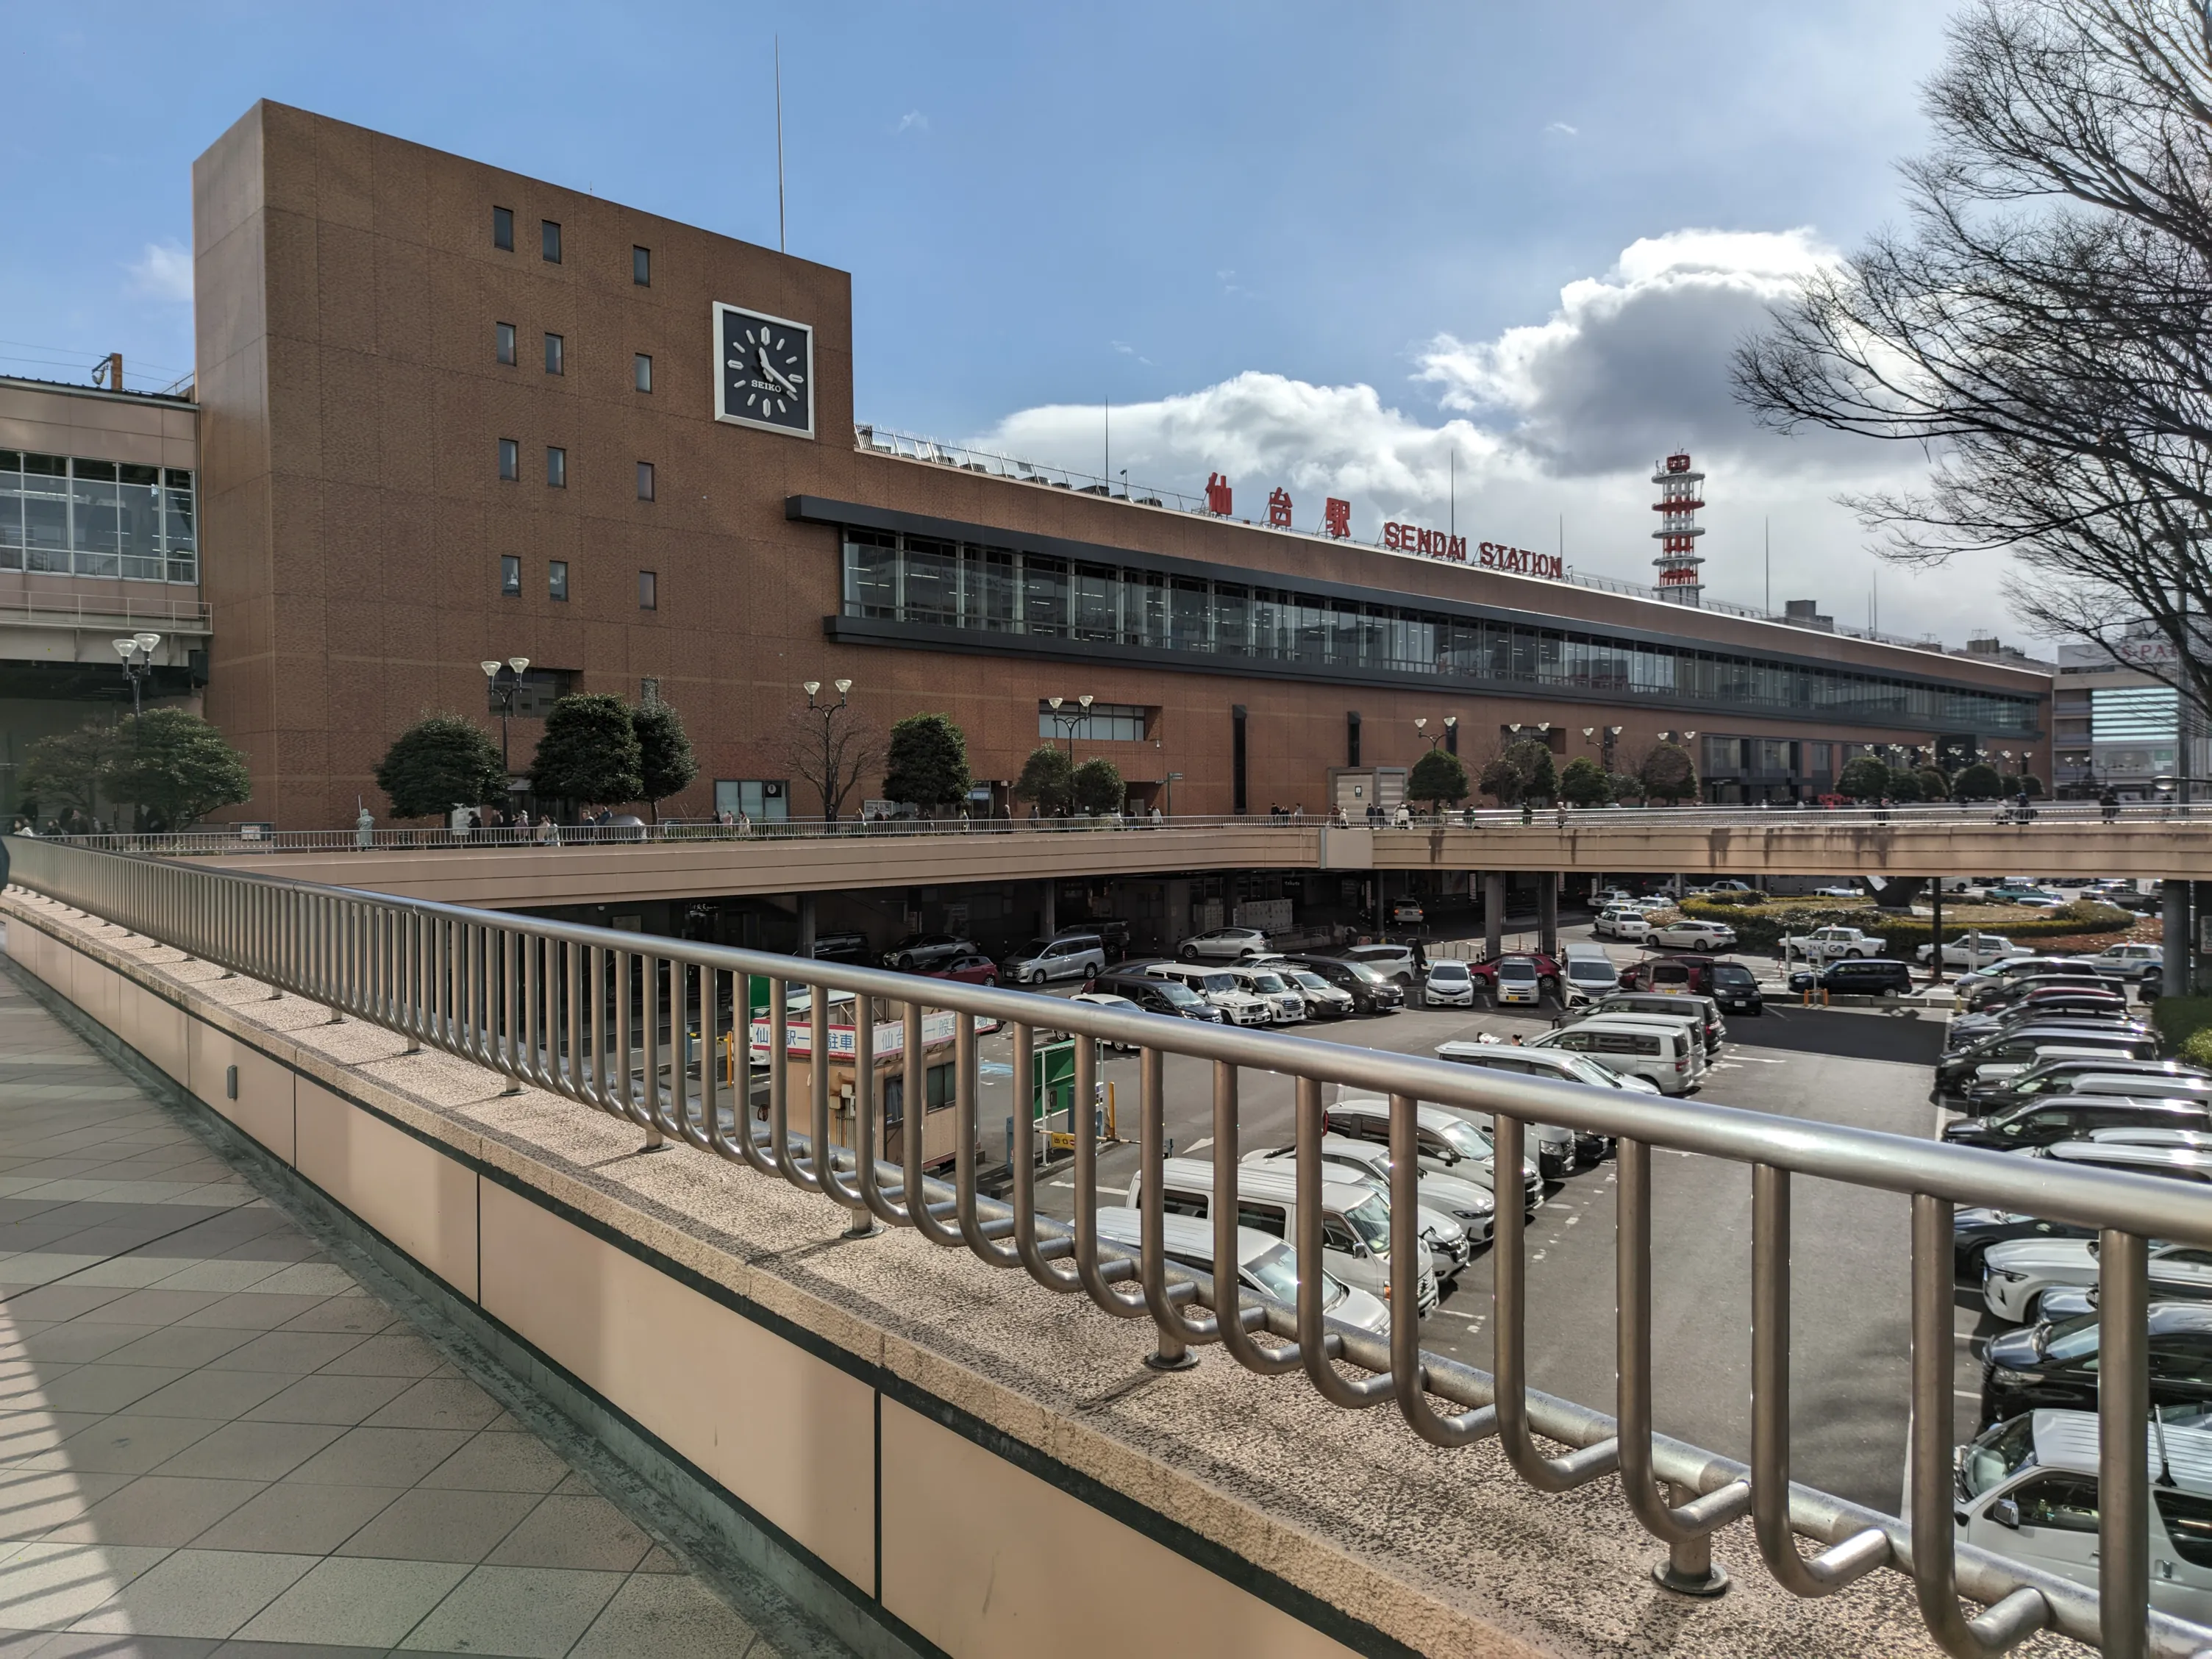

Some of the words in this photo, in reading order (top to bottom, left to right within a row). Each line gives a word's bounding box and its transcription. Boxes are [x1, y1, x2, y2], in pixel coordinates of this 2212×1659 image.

[751, 379, 782, 393] SEIKO
[1205, 472, 1351, 538] 仙台駅
[1385, 521, 1466, 560] SENDAI
[1480, 542, 1562, 579] STATION
[1828, 944, 1844, 952] GO
